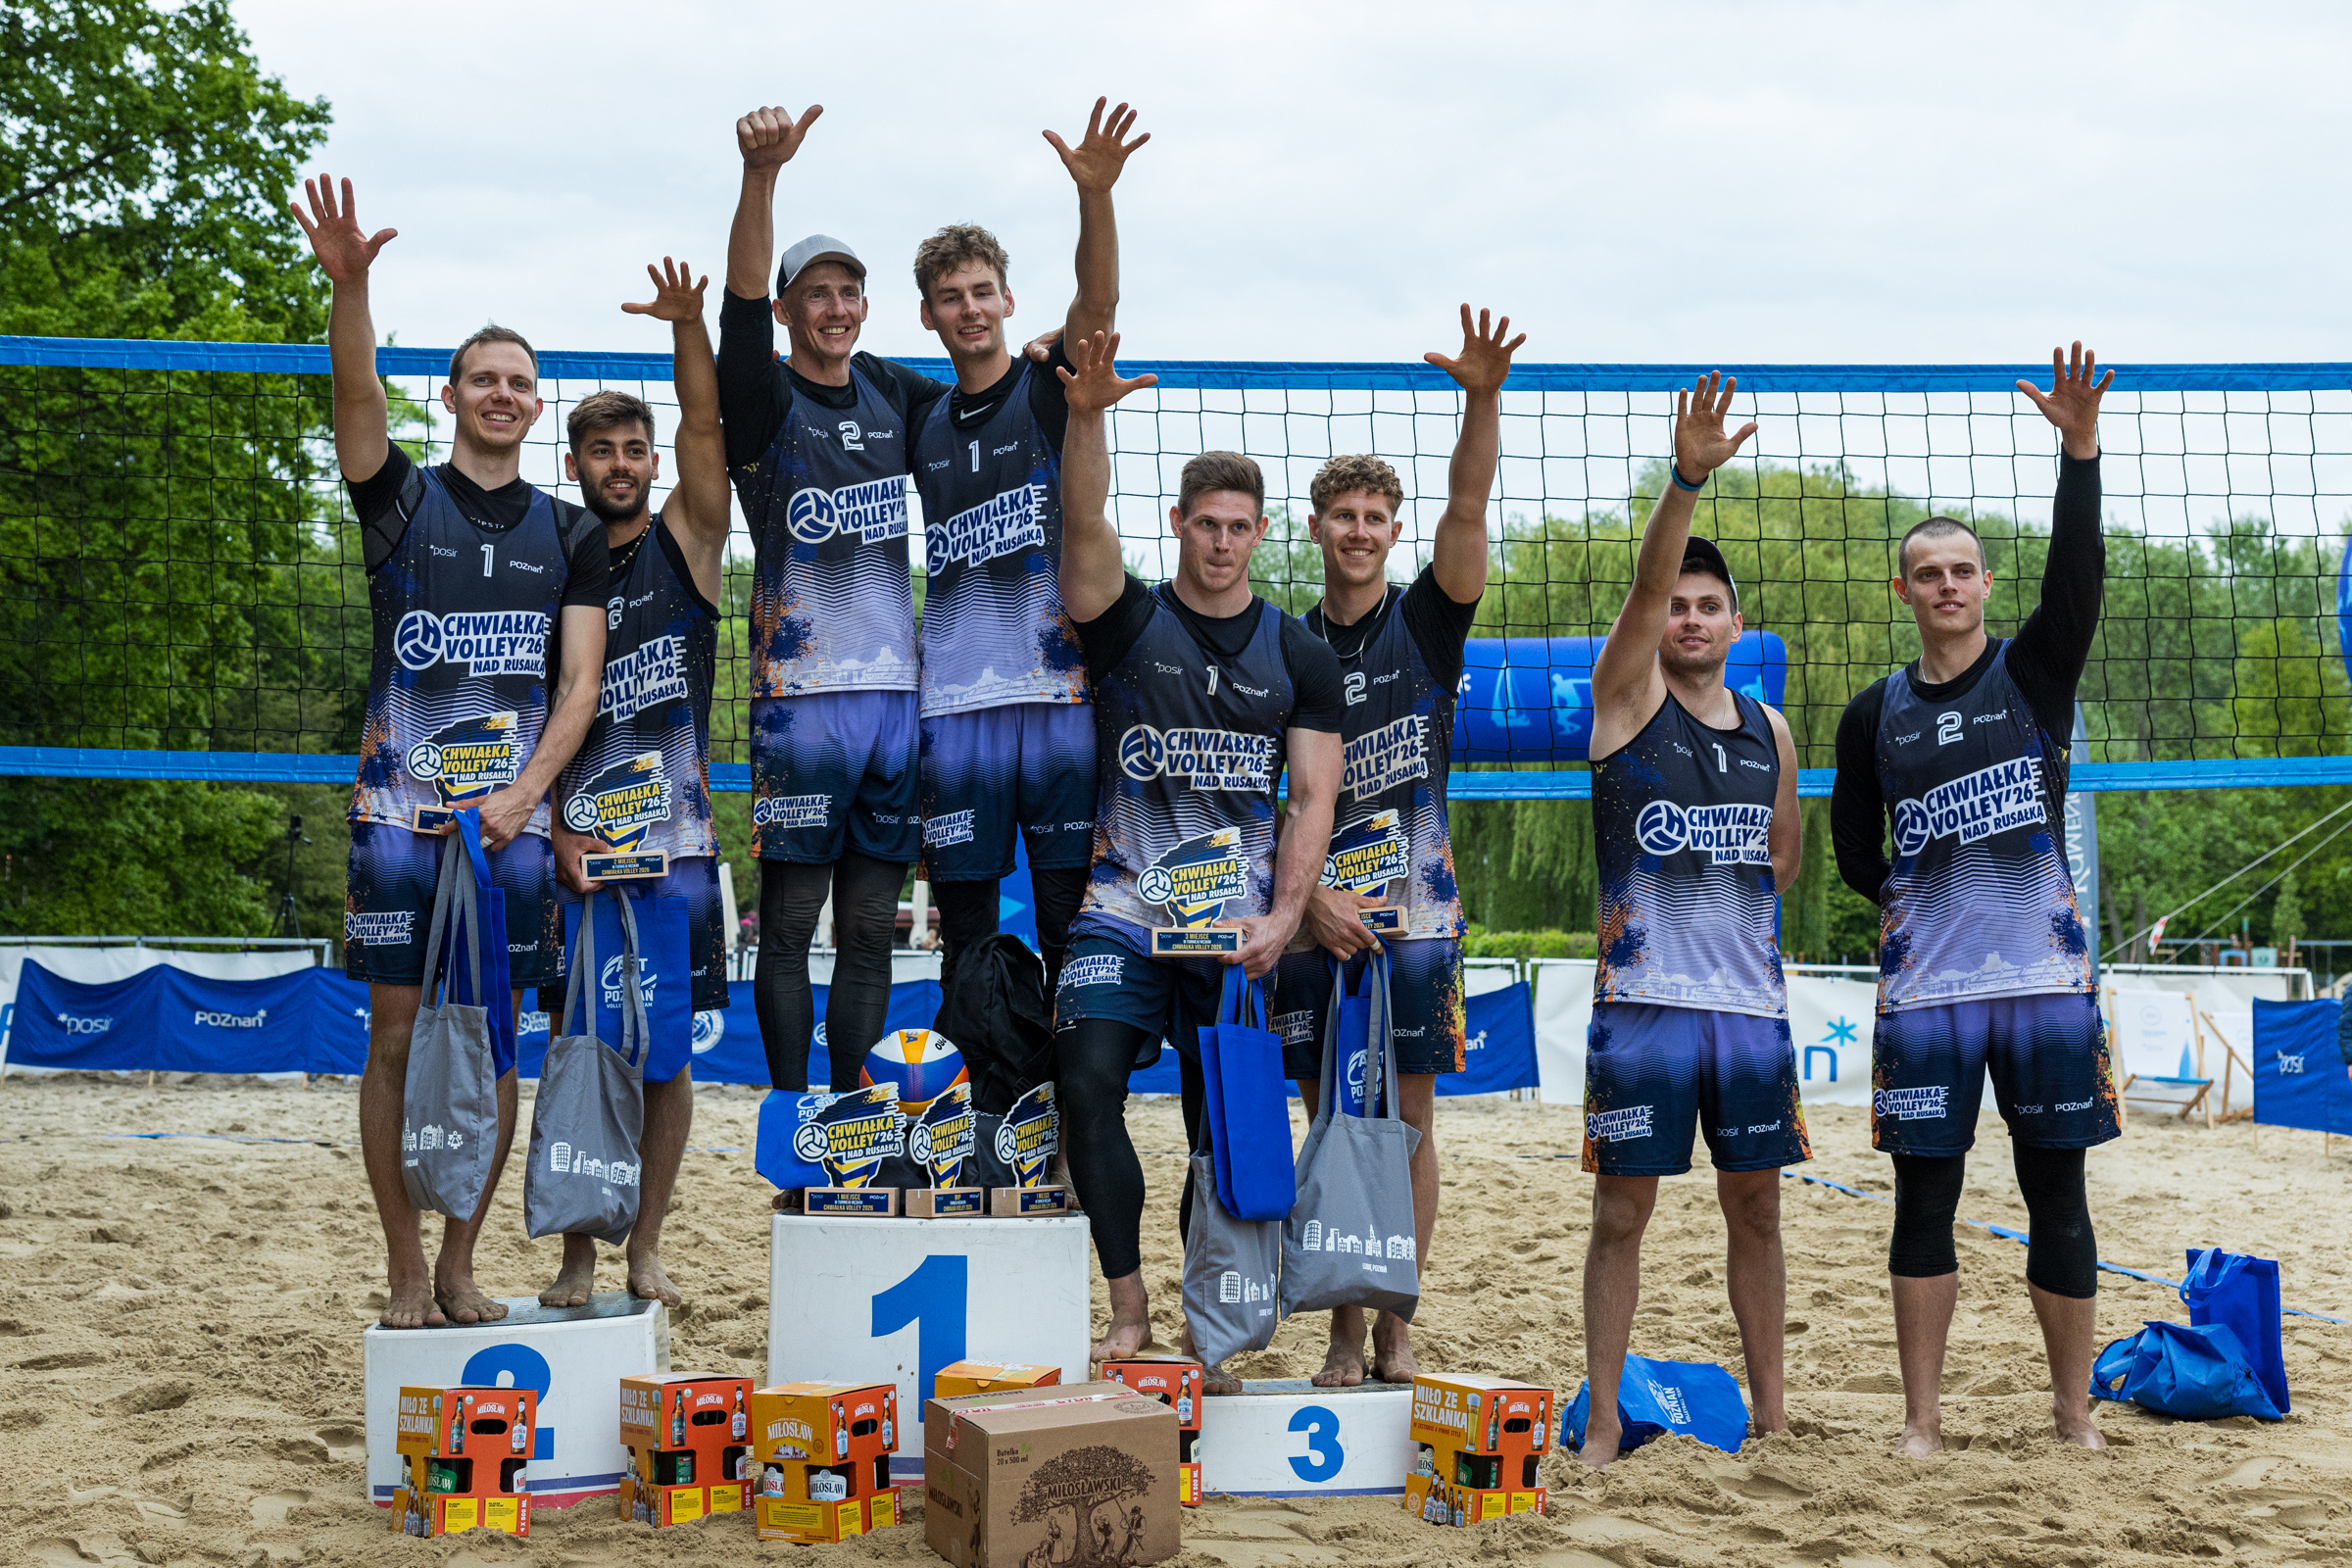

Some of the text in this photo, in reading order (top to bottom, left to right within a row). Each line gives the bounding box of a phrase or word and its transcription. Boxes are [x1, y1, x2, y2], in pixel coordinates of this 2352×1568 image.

[838, 420, 865, 451] 2
[968, 439, 980, 473] 1
[834, 477, 906, 511] CHWIAŁK
[949, 486, 1033, 539] CHWIAŁKA
[864, 526, 885, 541] NAD
[951, 509, 1033, 560] VOLLEY'26
[995, 528, 1043, 554] RUSAŁKĄ
[480, 543, 494, 578] 1
[607, 596, 625, 630] 2
[443, 613, 545, 637] CHWIAŁKA
[445, 636, 543, 661] VOLLEY'26
[472, 660, 500, 673] NAD
[503, 659, 546, 676] RUSAŁKĄ
[1158, 664, 1183, 675] posir
[1206, 665, 1219, 697] 1
[1344, 671, 1367, 707] 2
[638, 680, 686, 708] RUSAŁKĄ
[1898, 731, 1921, 746] posir
[1936, 710, 1964, 746] 2
[442, 744, 511, 760] CHWIAŁKA
[1165, 731, 1267, 756] CHWIAŁKA
[1344, 717, 1419, 767] HWIAŁKA
[443, 759, 509, 774] VOLLEY'26
[1167, 753, 1263, 774] VOLLEY'26
[1343, 740, 1419, 788] OLLEY'26
[1712, 742, 1728, 773] 1
[459, 770, 514, 782] NAD RUSAŁKĄ
[1195, 775, 1220, 787] NAD
[1224, 776, 1269, 792] RUSAŁKĄ
[1385, 760, 1426, 786] RUSAŁKĄ
[596, 783, 661, 808] CHWIAŁKA
[1357, 778, 1382, 798] NAD
[1926, 760, 2032, 814] CHWIAŁKA
[599, 796, 661, 821] VOLLEY'26
[772, 796, 824, 810] CHWIAŁKA
[772, 807, 823, 820] VOLLEY'26
[1931, 783, 2034, 836] VOLLEY'26
[616, 807, 666, 826] NAD RUSAŁKĄ
[801, 817, 827, 826] RUSAŁKĄ
[876, 814, 900, 824] posir
[926, 810, 968, 832] CHWIAŁKA
[1993, 805, 2044, 831] RUSAŁKĄ
[927, 821, 968, 842] VOLLEY'26
[937, 833, 973, 847] NAD RUSAŁKĄ
[1690, 827, 1769, 849] VOLLEY'2
[1962, 821, 1989, 841] NAD
[1335, 841, 1398, 868] CHWIAŁKA
[1716, 849, 1740, 862] NAD
[1171, 859, 1238, 883] CHWIAŁKA
[1338, 853, 1397, 880] VOLLEY'26
[1355, 865, 1404, 885] NAD RUSAŁKĄ
[1173, 873, 1237, 896] VOLLEY'26
[1191, 885, 1243, 902] NAD RUSAŁKĄ
[356, 912, 407, 924] CHWIAŁKA
[356, 923, 406, 937] VOLLEY'26
[380, 934, 411, 944] RUSAŁKĄ
[1065, 956, 1117, 974] CHWIAŁKA
[1065, 965, 1116, 984] VOLLEY'26
[67, 1014, 114, 1035] posir
[1887, 1088, 1941, 1102] CHWIAŁKA
[1888, 1098, 1940, 1111] VOLLEY'26
[1598, 1106, 1646, 1124] CHWIAŁKA
[1900, 1108, 1945, 1119] NAD RUSAŁKĄ
[2018, 1104, 2043, 1115] posir
[827, 1116, 895, 1139] CHWIAŁKA
[930, 1116, 969, 1140] CHWIAŁKA
[1015, 1115, 1054, 1140] CHWIAŁKA
[1599, 1118, 1645, 1135] VOLLEY'26
[1610, 1127, 1651, 1141] NAD RUSAŁKĄ
[829, 1130, 894, 1152] VOLLEY'26
[847, 1143, 900, 1159] NAD RUSAŁKĄ
[931, 1130, 969, 1153] VOLLEY'26
[942, 1142, 973, 1159] NAD RUSAŁKĄ
[1016, 1130, 1053, 1154] VOLLEY'26
[1026, 1141, 1056, 1159] NAD RUSAŁKĄ
[872, 1255, 967, 1422] 1
[1138, 1377, 1168, 1388] MIŁOSŁAW
[401, 1396, 428, 1414] MIŁO ZE
[462, 1344, 553, 1460] 2
[621, 1388, 647, 1408] MIŁO ZE
[696, 1396, 723, 1407] MIŁOSŁAW
[1415, 1385, 1458, 1409] MIŁO ZE
[1663, 1387, 1688, 1425] POZNAŃ
[476, 1404, 506, 1415] MIŁOSŁAW
[621, 1407, 654, 1431] SZKLANKĄ
[1413, 1402, 1468, 1433] SZKLANKĄ
[399, 1415, 433, 1438] SZKLANKĄ
[767, 1421, 813, 1443] MIŁOSŁAW
[997, 1447, 1019, 1457] Butelka
[1289, 1406, 1345, 1483] 3
[1047, 1477, 1122, 1500] MIŁOSŁAWSKI
